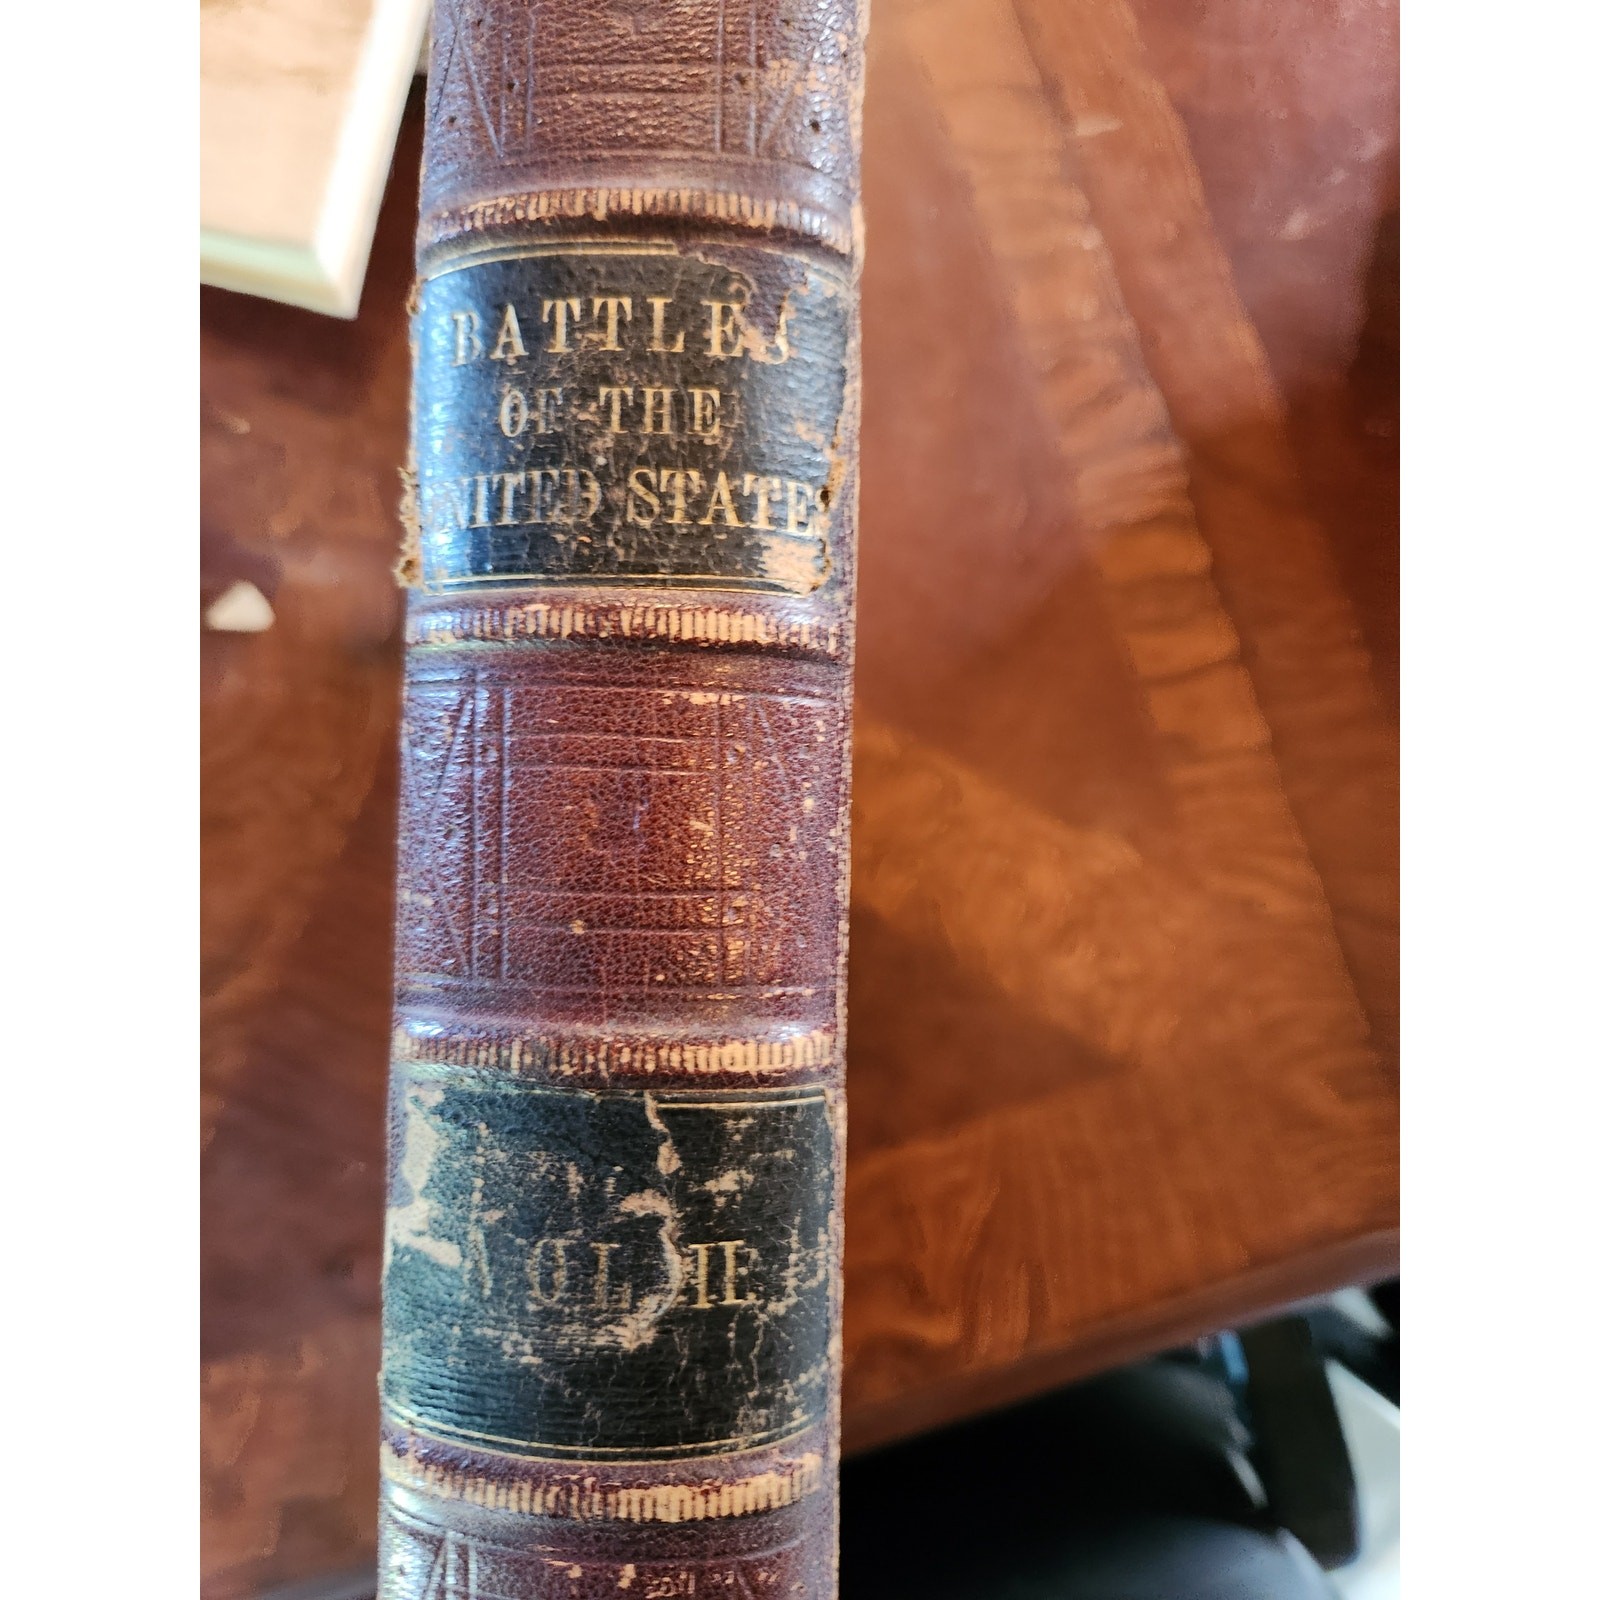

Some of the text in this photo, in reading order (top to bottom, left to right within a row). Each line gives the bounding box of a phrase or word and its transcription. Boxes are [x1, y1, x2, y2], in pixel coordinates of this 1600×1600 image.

[500, 385, 722, 438] OF THE
[421, 468, 602, 530] NITED
